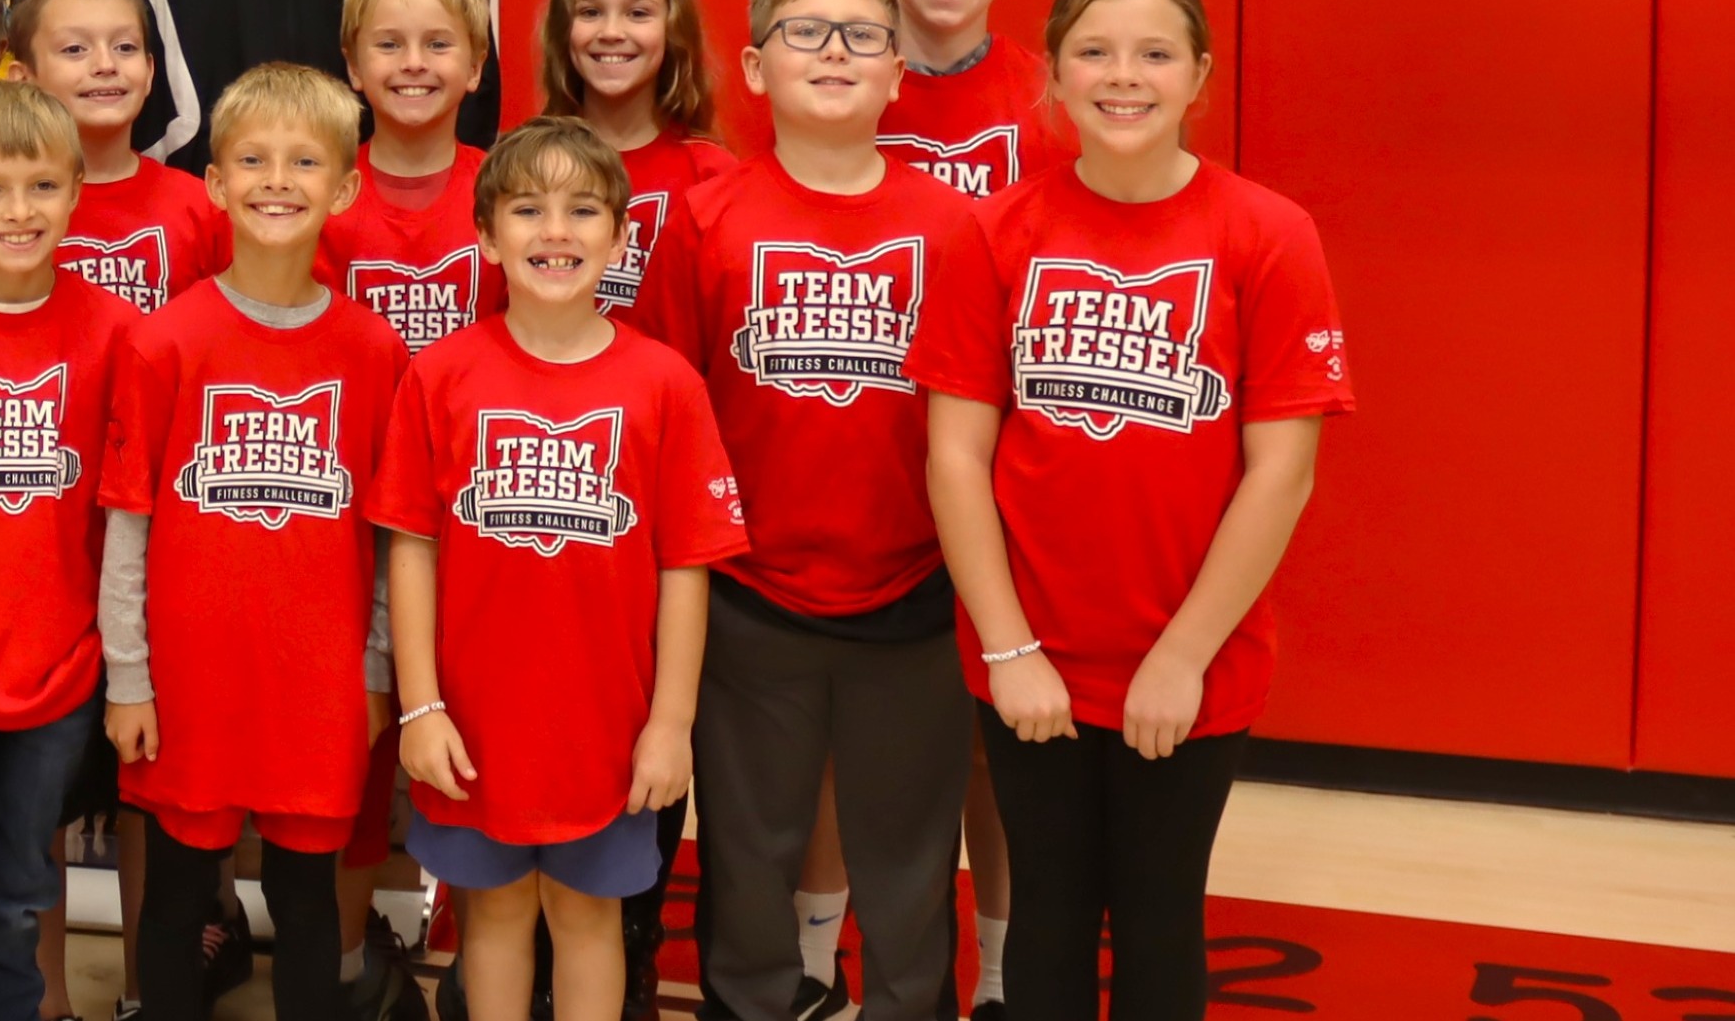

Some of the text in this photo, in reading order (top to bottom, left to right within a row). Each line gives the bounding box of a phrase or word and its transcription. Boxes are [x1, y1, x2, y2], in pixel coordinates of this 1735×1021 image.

[366, 283, 459, 313] TEAM
[595, 282, 637, 297] HALLENG
[778, 272, 894, 309] TEAM
[1047, 291, 1173, 339] TEAM
[770, 358, 821, 371] FITNESS
[1018, 327, 1197, 382] TRESSEL
[1035, 382, 1175, 414] FITNESS CHALLENGE
[223, 412, 318, 447] TEAM
[200, 442, 339, 479] TRESSEL
[496, 437, 595, 473] TEAM
[5, 473, 57, 485] CHALLENG
[476, 468, 613, 506] TRESSEL
[217, 488, 325, 505] FITNESS CHALLENGE
[489, 513, 602, 533] FITNESS CHALLENGE
